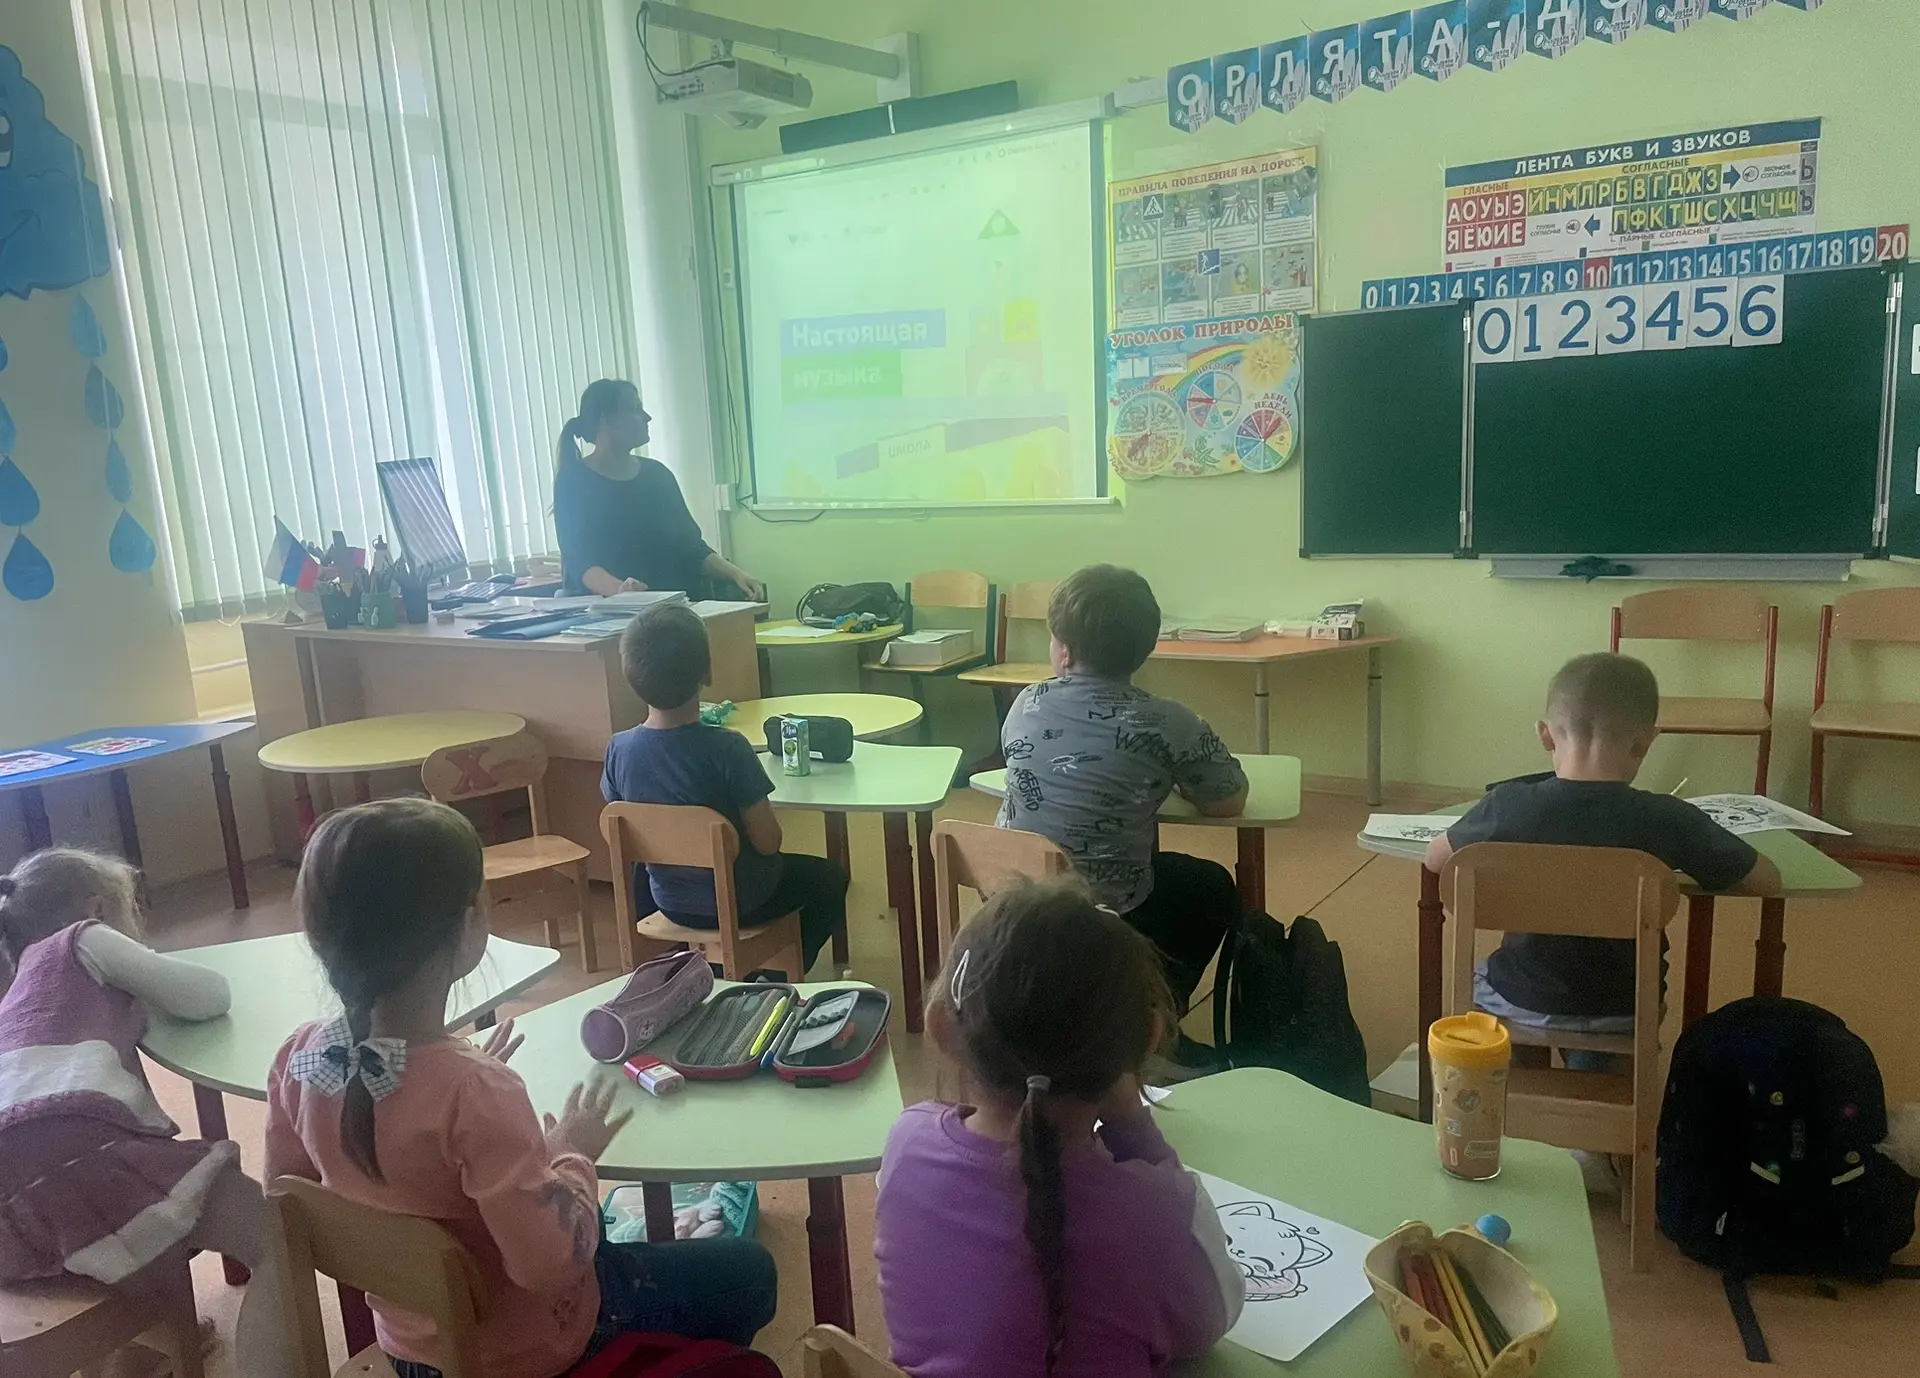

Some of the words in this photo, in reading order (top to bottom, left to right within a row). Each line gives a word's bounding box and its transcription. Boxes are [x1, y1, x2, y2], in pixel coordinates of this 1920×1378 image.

[1515, 154, 1574, 175] ЛЕНТА
[1586, 146, 1634, 165] БУКВ
[1646, 142, 1659, 157] И
[1672, 130, 1751, 153] ЗВУКОВ
[1621, 157, 1690, 174] СОГЛАСНЫЕ
[1118, 180, 1168, 198] ПРАВИЛА
[1172, 167, 1238, 188] ПОВЕДЕНИЯ
[1241, 165, 1257, 176] НА
[1463, 182, 1509, 196] ГЛАСНЫЕ
[1619, 232, 1655, 244] ПАРНЫЕ
[1659, 227, 1711, 239] СОГЛАСНЫЕ
[1366, 286, 1378, 309] 0
[1388, 285, 1396, 306] 1
[1409, 283, 1420, 305] 2
[1431, 281, 1440, 303] 3
[1451, 279, 1463, 300] 4
[1474, 277, 1485, 298] 5
[1495, 275, 1508, 298] 6
[1519, 273, 1532, 295] 7
[1541, 270, 1554, 293] 8
[1565, 268, 1578, 290] 9
[1587, 266, 1608, 288] 10
[1613, 262, 1634, 285] 11
[1642, 260, 1662, 282] 12
[1670, 256, 1692, 280] 13
[1698, 253, 1722, 277] 14
[1728, 249, 1751, 275] 15
[1758, 246, 1782, 273] 16
[1788, 242, 1812, 269] 17
[1818, 238, 1843, 267] 18
[1849, 235, 1874, 264] 19
[1878, 231, 1907, 261] 20
[1111, 326, 1185, 348] УГОЛОК
[1194, 315, 1293, 337] ПРИРОДЫ
[1477, 307, 1511, 355] 0
[1524, 304, 1542, 352] 1
[1558, 299, 1591, 349] 2
[1605, 295, 1636, 345] 3
[1646, 291, 1683, 341] 4
[1693, 286, 1729, 338] 5
[1740, 284, 1776, 337] 6
[792, 322, 927, 347] Настоящая
[888, 440, 931, 458] ШКОЛА
